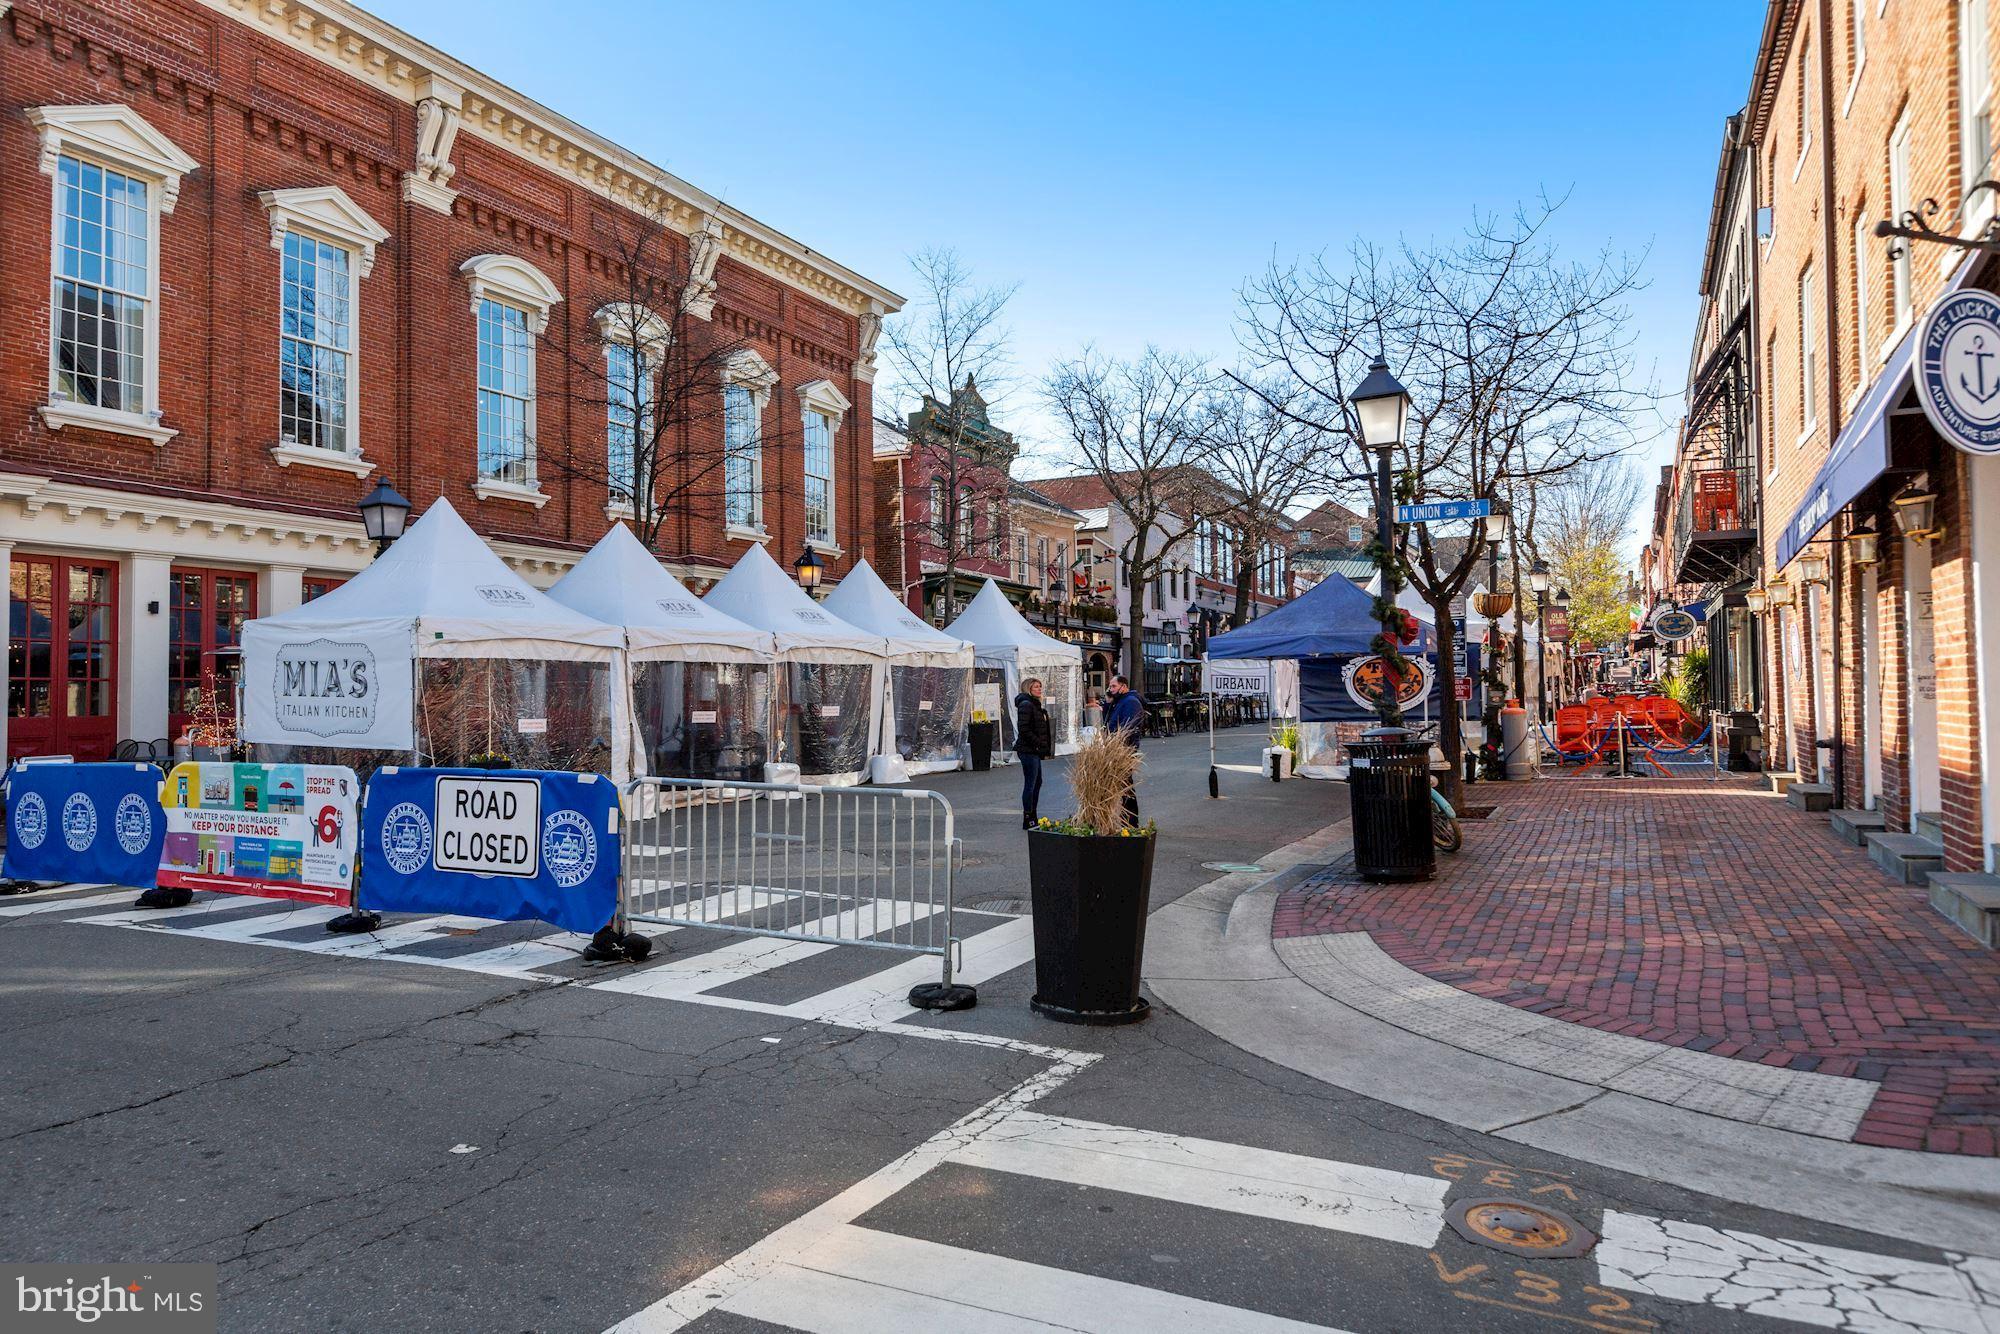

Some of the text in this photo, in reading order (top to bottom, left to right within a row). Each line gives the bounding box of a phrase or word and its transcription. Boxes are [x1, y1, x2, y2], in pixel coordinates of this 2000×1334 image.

[1928, 301, 1995, 348] THE LUCKY
[1931, 384, 1979, 441] ADVENTURE
[1401, 505, 1440, 520] N UNION
[1468, 508, 1482, 516] 100
[1470, 501, 1480, 509] ST
[479, 589, 526, 601] MIA'S
[282, 658, 369, 699] MIA'S
[1215, 676, 1261, 690] URBANO
[282, 704, 369, 719] ITALIAN KITCHEN
[306, 777, 323, 786] STOP
[323, 778, 336, 786] THE
[306, 786, 331, 795] SPREAD
[455, 789, 518, 820] ROAD
[184, 811, 289, 826] NO MATTER HOW YOU MEASURE IT,
[318, 804, 343, 844] 6 ft
[191, 821, 280, 836] KEEP YOUR DISTANCE.
[443, 830, 529, 865] CLOSED
